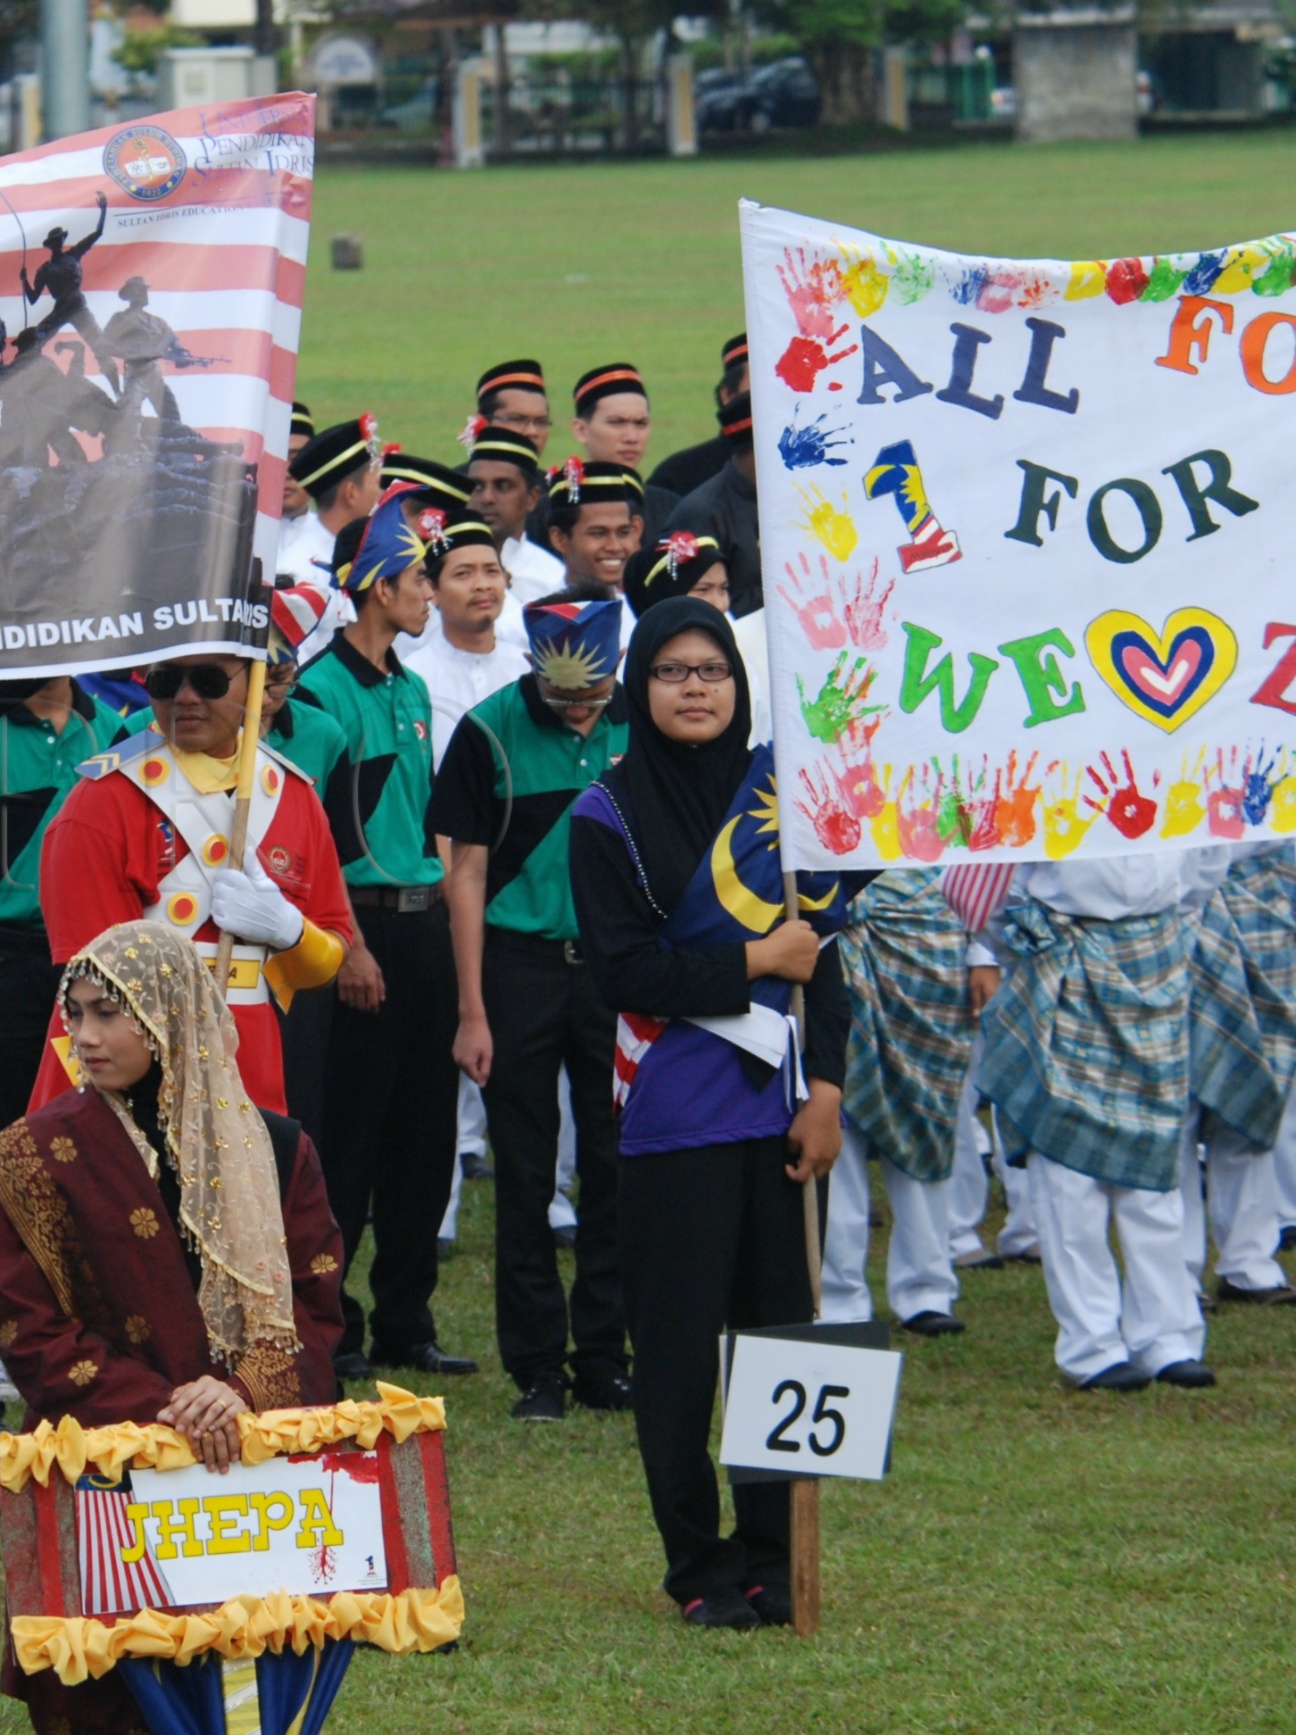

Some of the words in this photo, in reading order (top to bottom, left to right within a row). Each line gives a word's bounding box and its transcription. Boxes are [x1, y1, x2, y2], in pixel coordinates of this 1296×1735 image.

[264, 149, 314, 177] IDRIS
[117, 214, 154, 228] SULTAN
[155, 210, 180, 222] IDRIS
[856, 317, 1080, 420] ALL
[1004, 449, 1260, 564] FOR
[899, 621, 1086, 734] WE
[765, 1378, 851, 1457] 25
[120, 1487, 344, 1564] JHEPA
